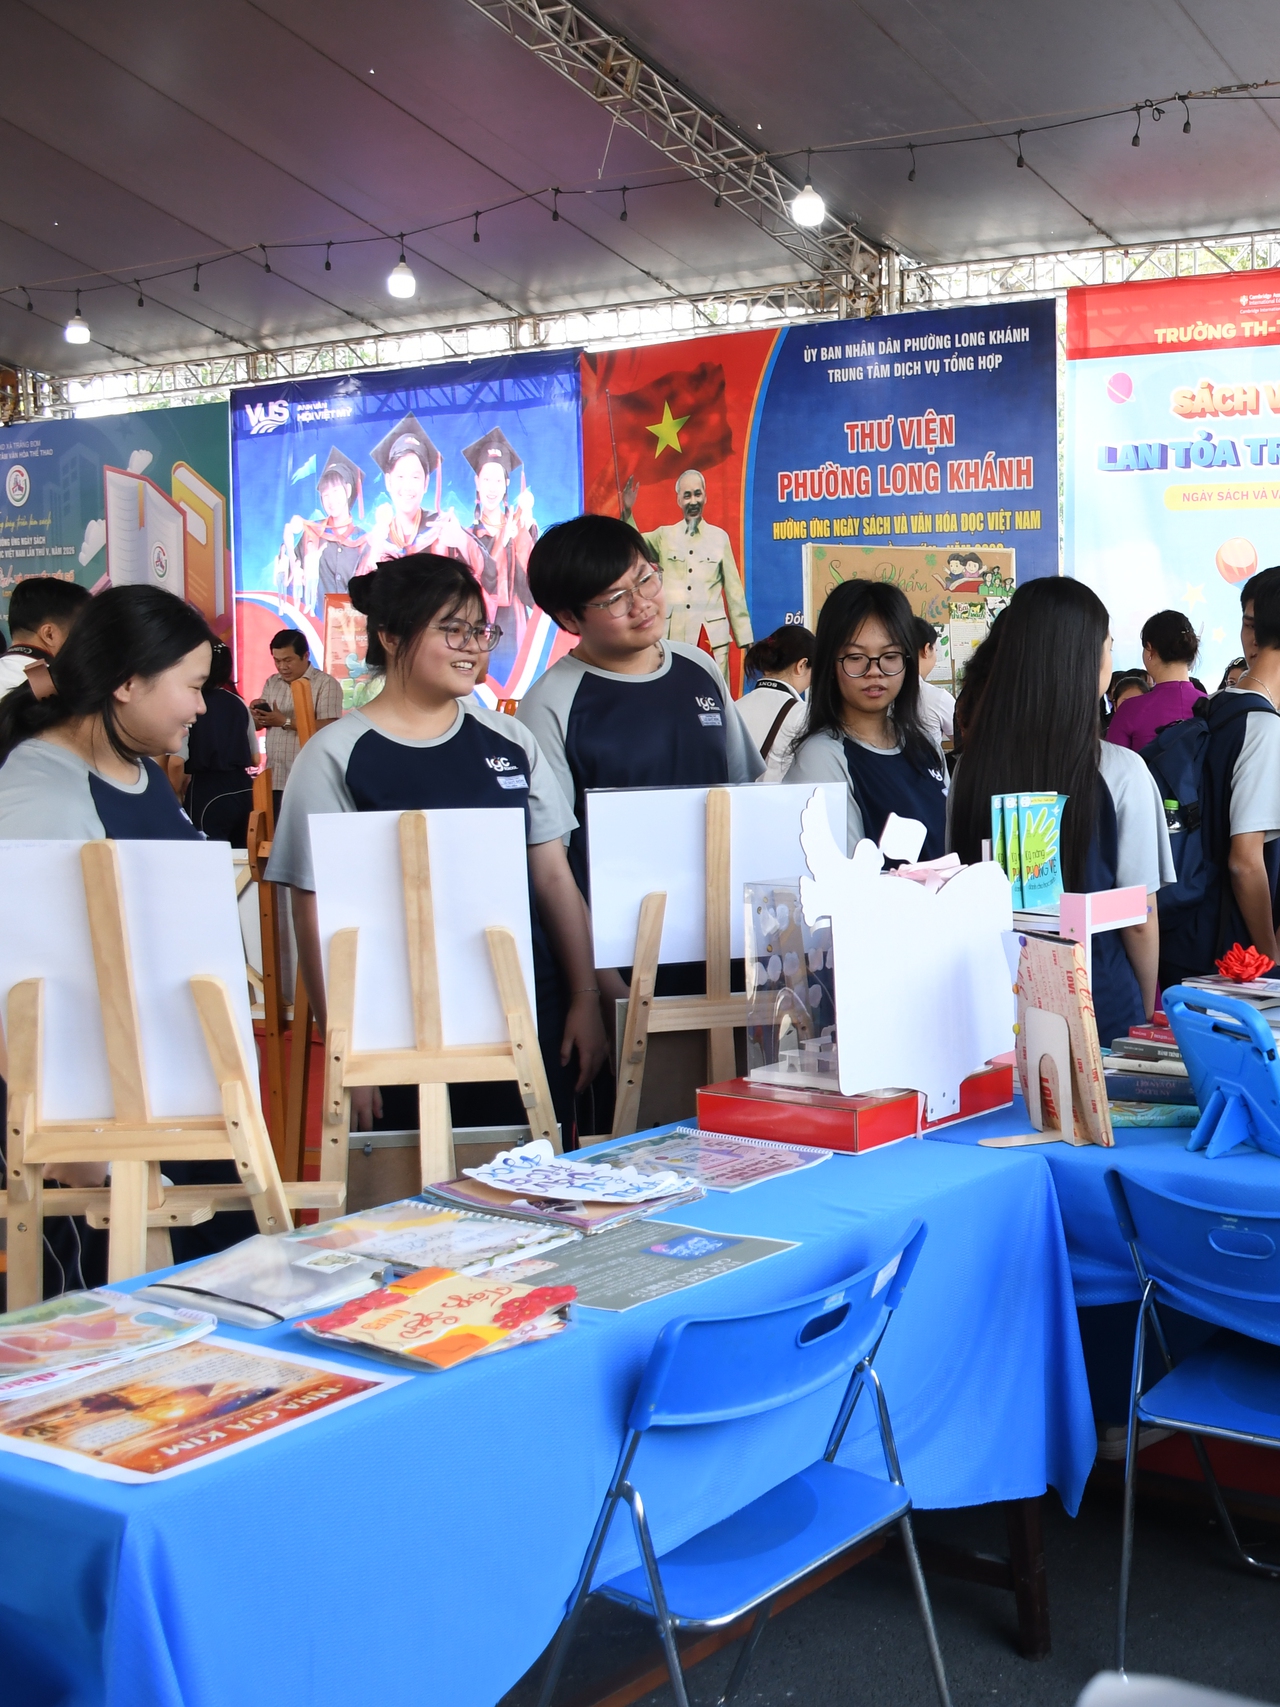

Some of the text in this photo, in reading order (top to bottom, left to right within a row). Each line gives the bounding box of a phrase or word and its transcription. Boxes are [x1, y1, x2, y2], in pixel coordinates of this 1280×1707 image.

[803, 326, 1030, 363] ỦY BAN NHÂN DÂN PHƯỜNG LONG KHÁNH
[1154, 321, 1237, 345] TRƯỜNG
[828, 352, 1003, 383] TRUNG TÂM DỊCH VỤ TỔNG HỢP
[1171, 381, 1260, 419] SÁCH
[844, 408, 955, 455] THƯ VIỆN
[1098, 441, 1169, 472] LAN
[1168, 429, 1241, 470] TỎA
[778, 451, 1034, 503] PHƯỜNG LONG KHÁNH
[1182, 488, 1214, 503] NGÀY
[1217, 487, 1249, 502] SÁCH
[1253, 487, 1268, 501] VÀ
[773, 508, 1041, 540] HƯỞNG ỨNG NGÀY SÁCH VÀ VĂN HÓA ĐỌC VIỆT NAM
[1065, 970, 1077, 996] LOVE
[1041, 1076, 1059, 1120] LOVE
[159, 1429, 228, 1456] KIM
